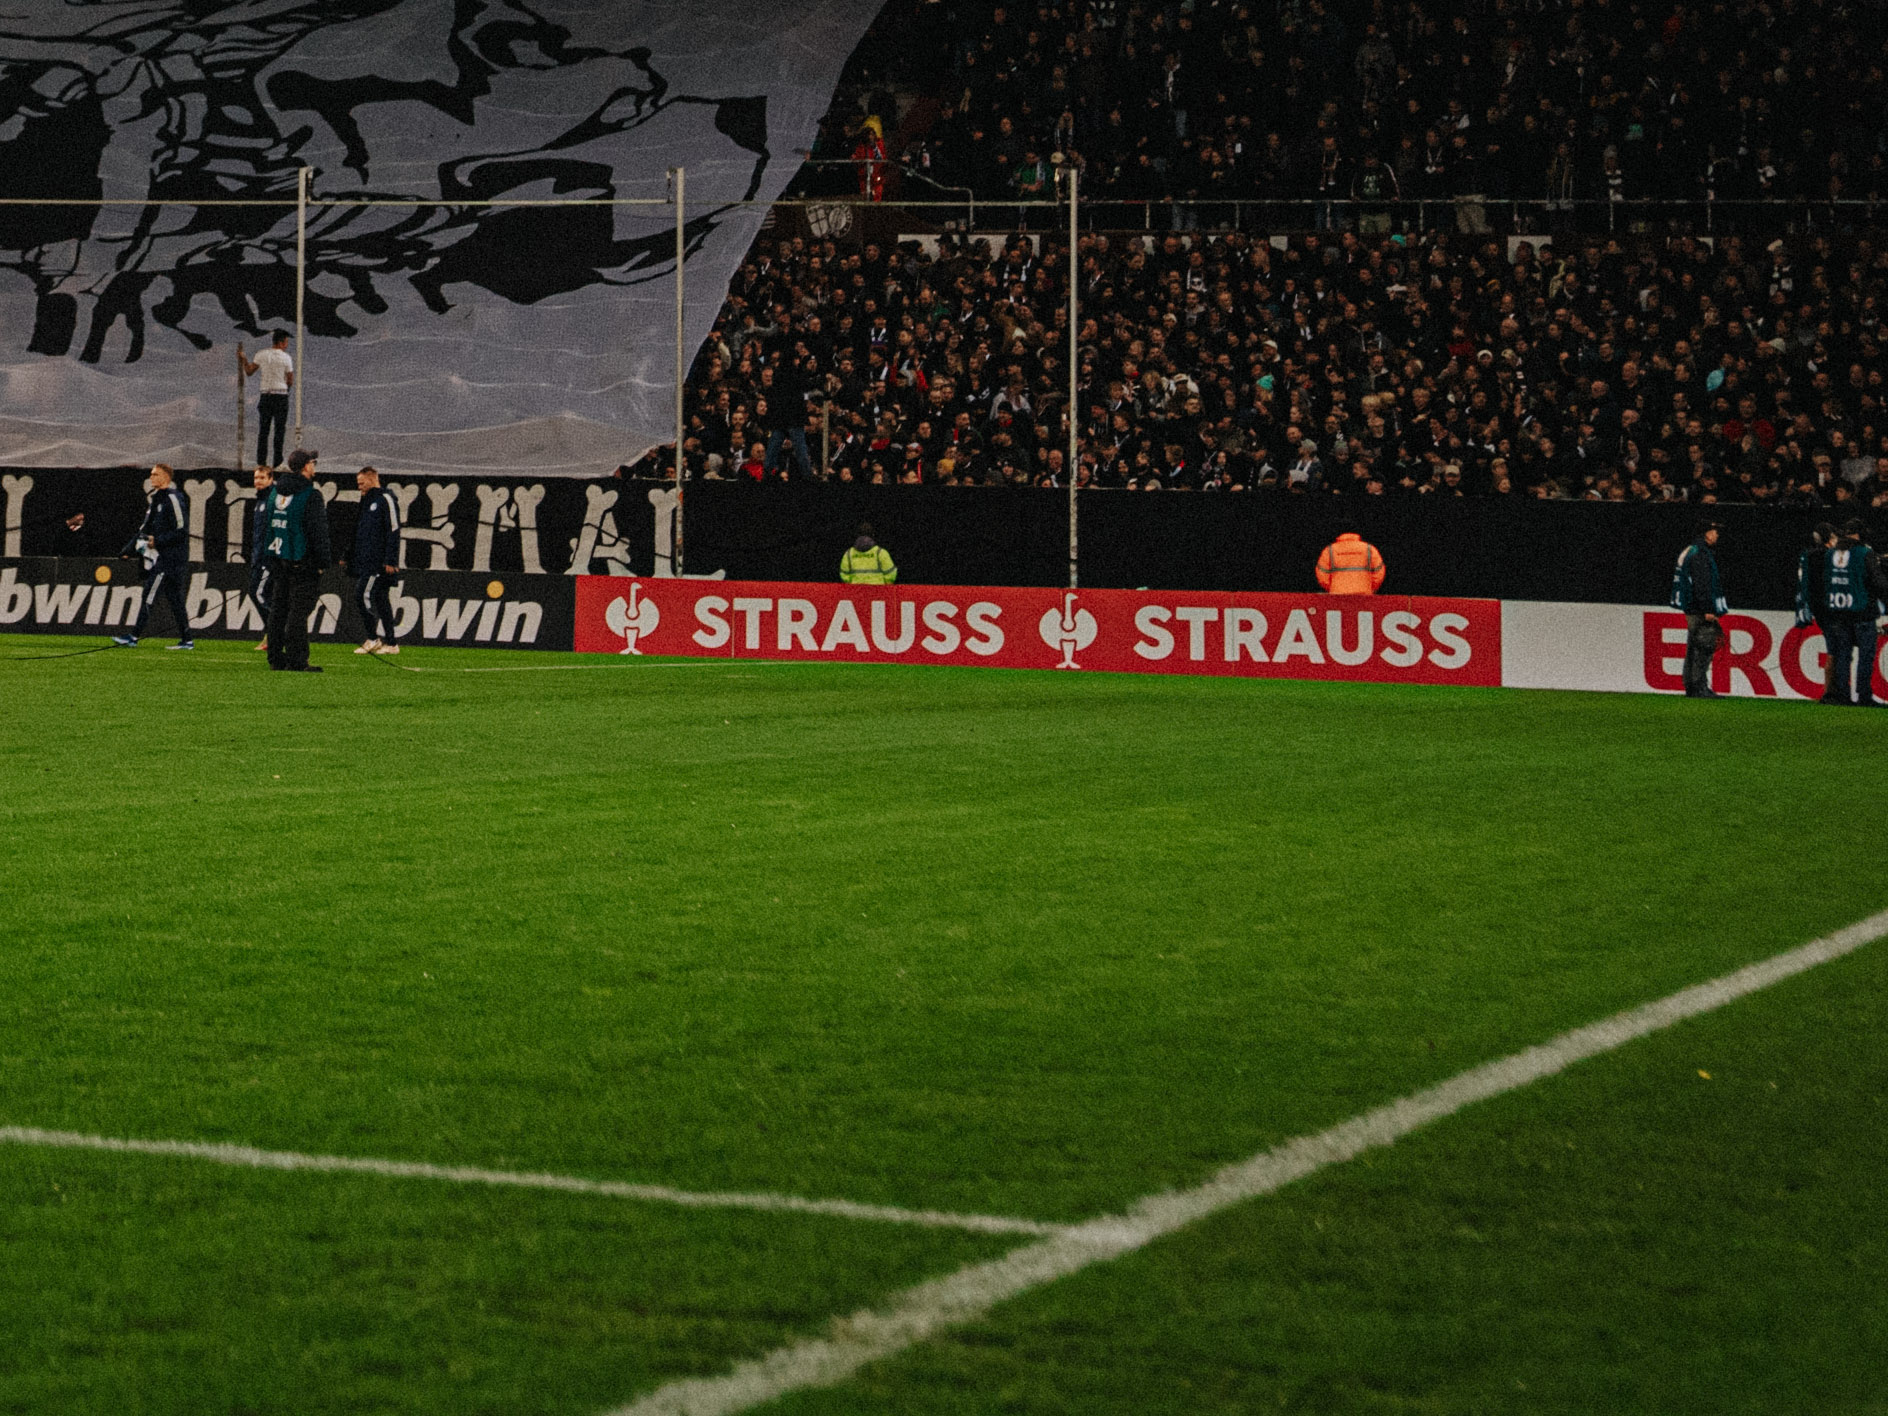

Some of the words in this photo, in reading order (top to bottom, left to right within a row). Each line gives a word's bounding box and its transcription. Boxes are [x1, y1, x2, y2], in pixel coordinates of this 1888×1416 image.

[185, 571, 342, 634] bwn
[692, 595, 1005, 656] STRAUSS
[1131, 604, 1472, 670] STRAUSS
